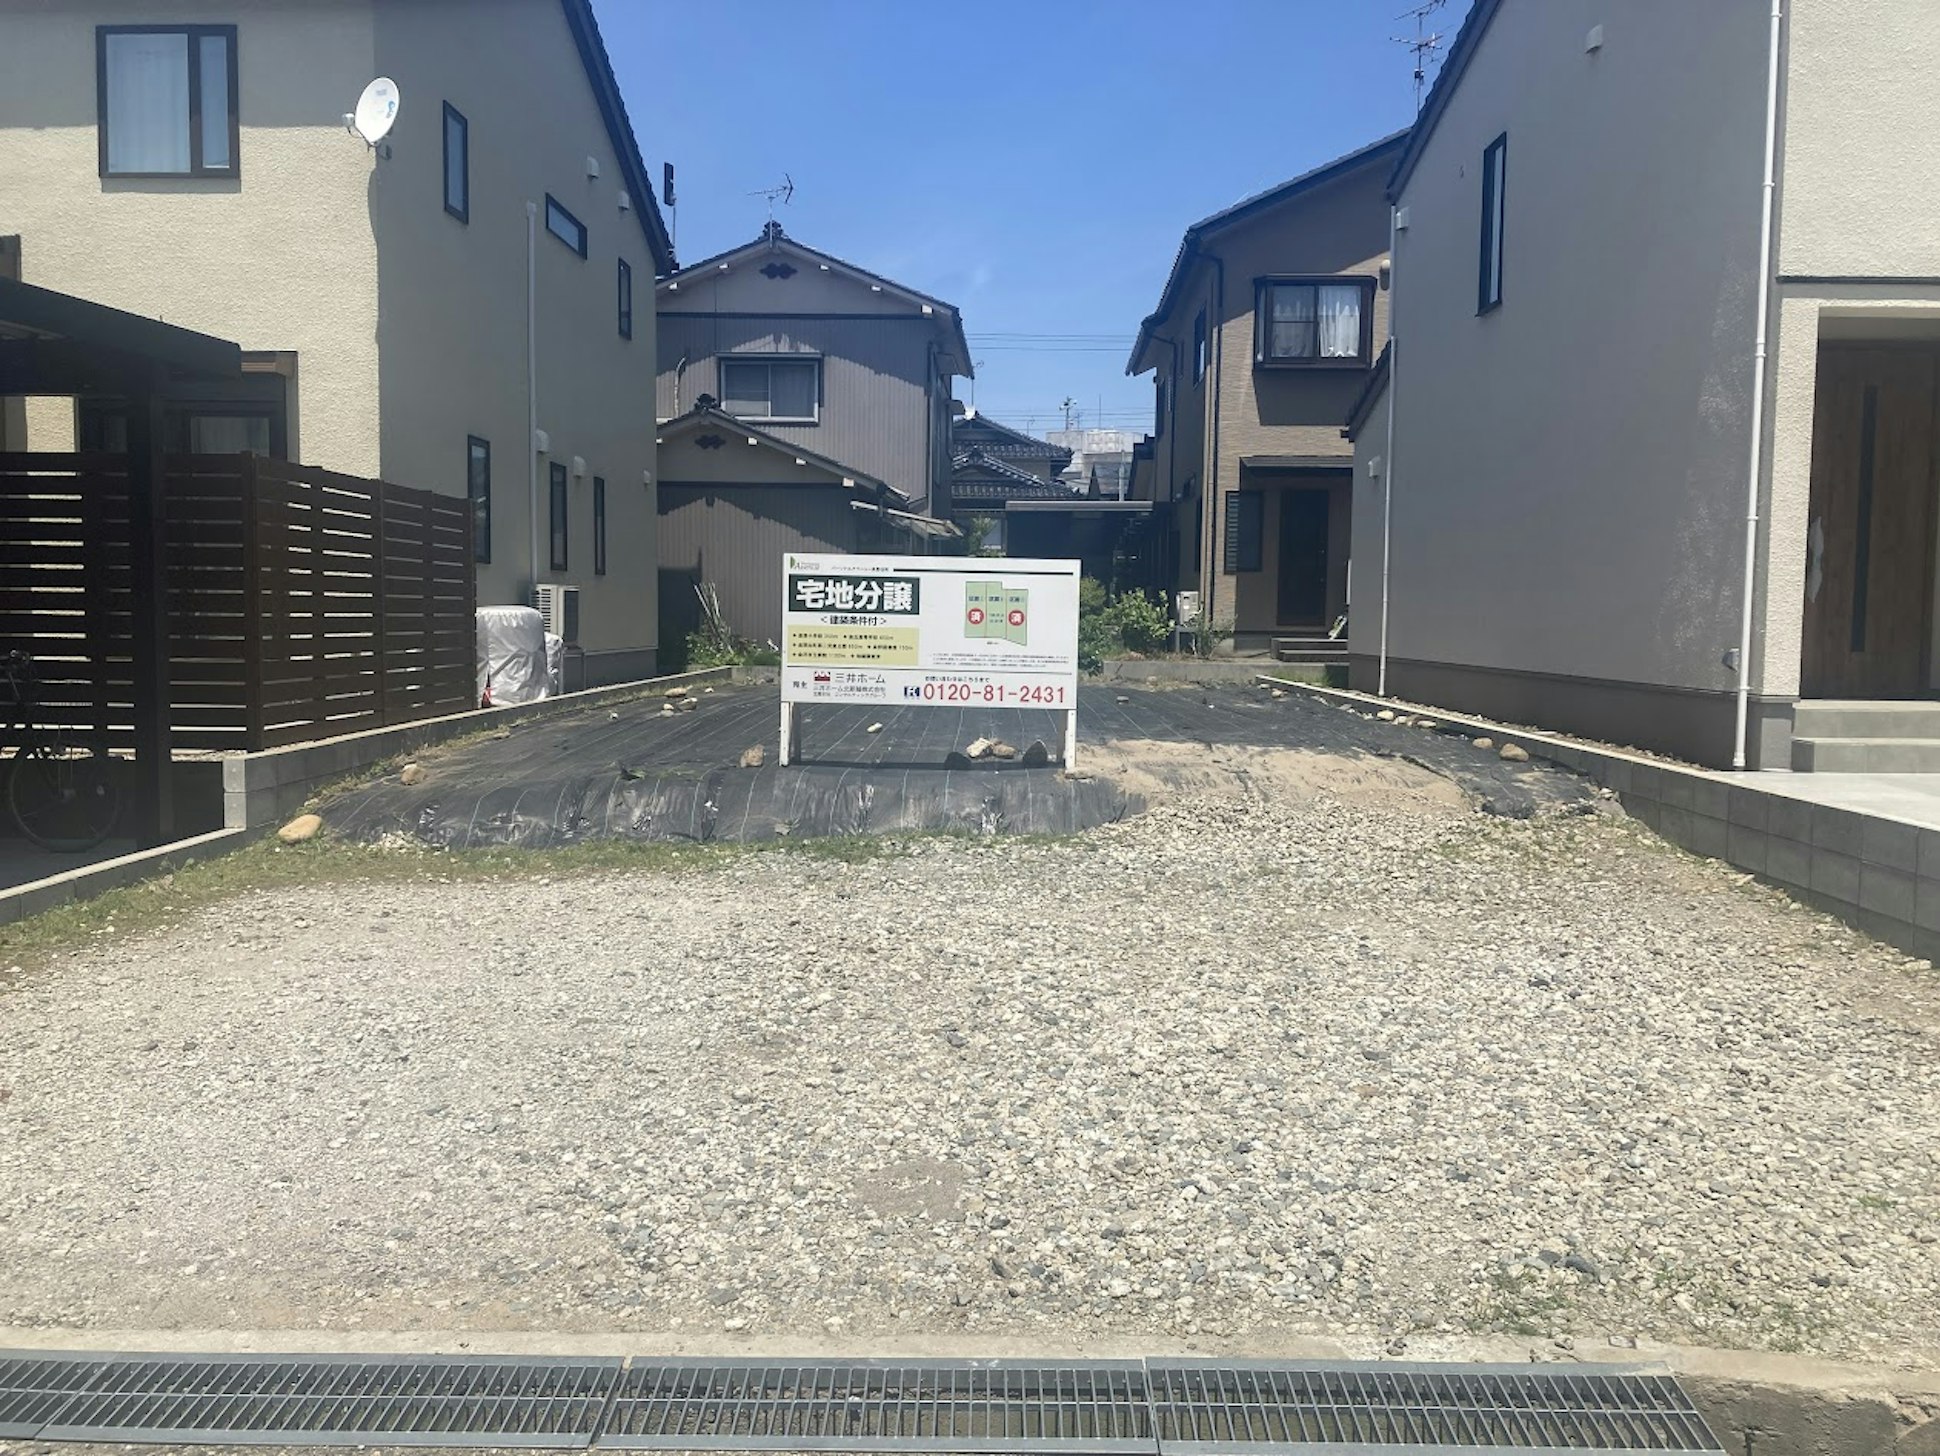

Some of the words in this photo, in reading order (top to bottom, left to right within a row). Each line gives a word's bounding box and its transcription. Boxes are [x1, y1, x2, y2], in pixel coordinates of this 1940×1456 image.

[795, 577, 913, 611] 宅地分譲
[835, 672, 886, 684] 三井ホーム
[923, 683, 1065, 704] 0120-81-2431
